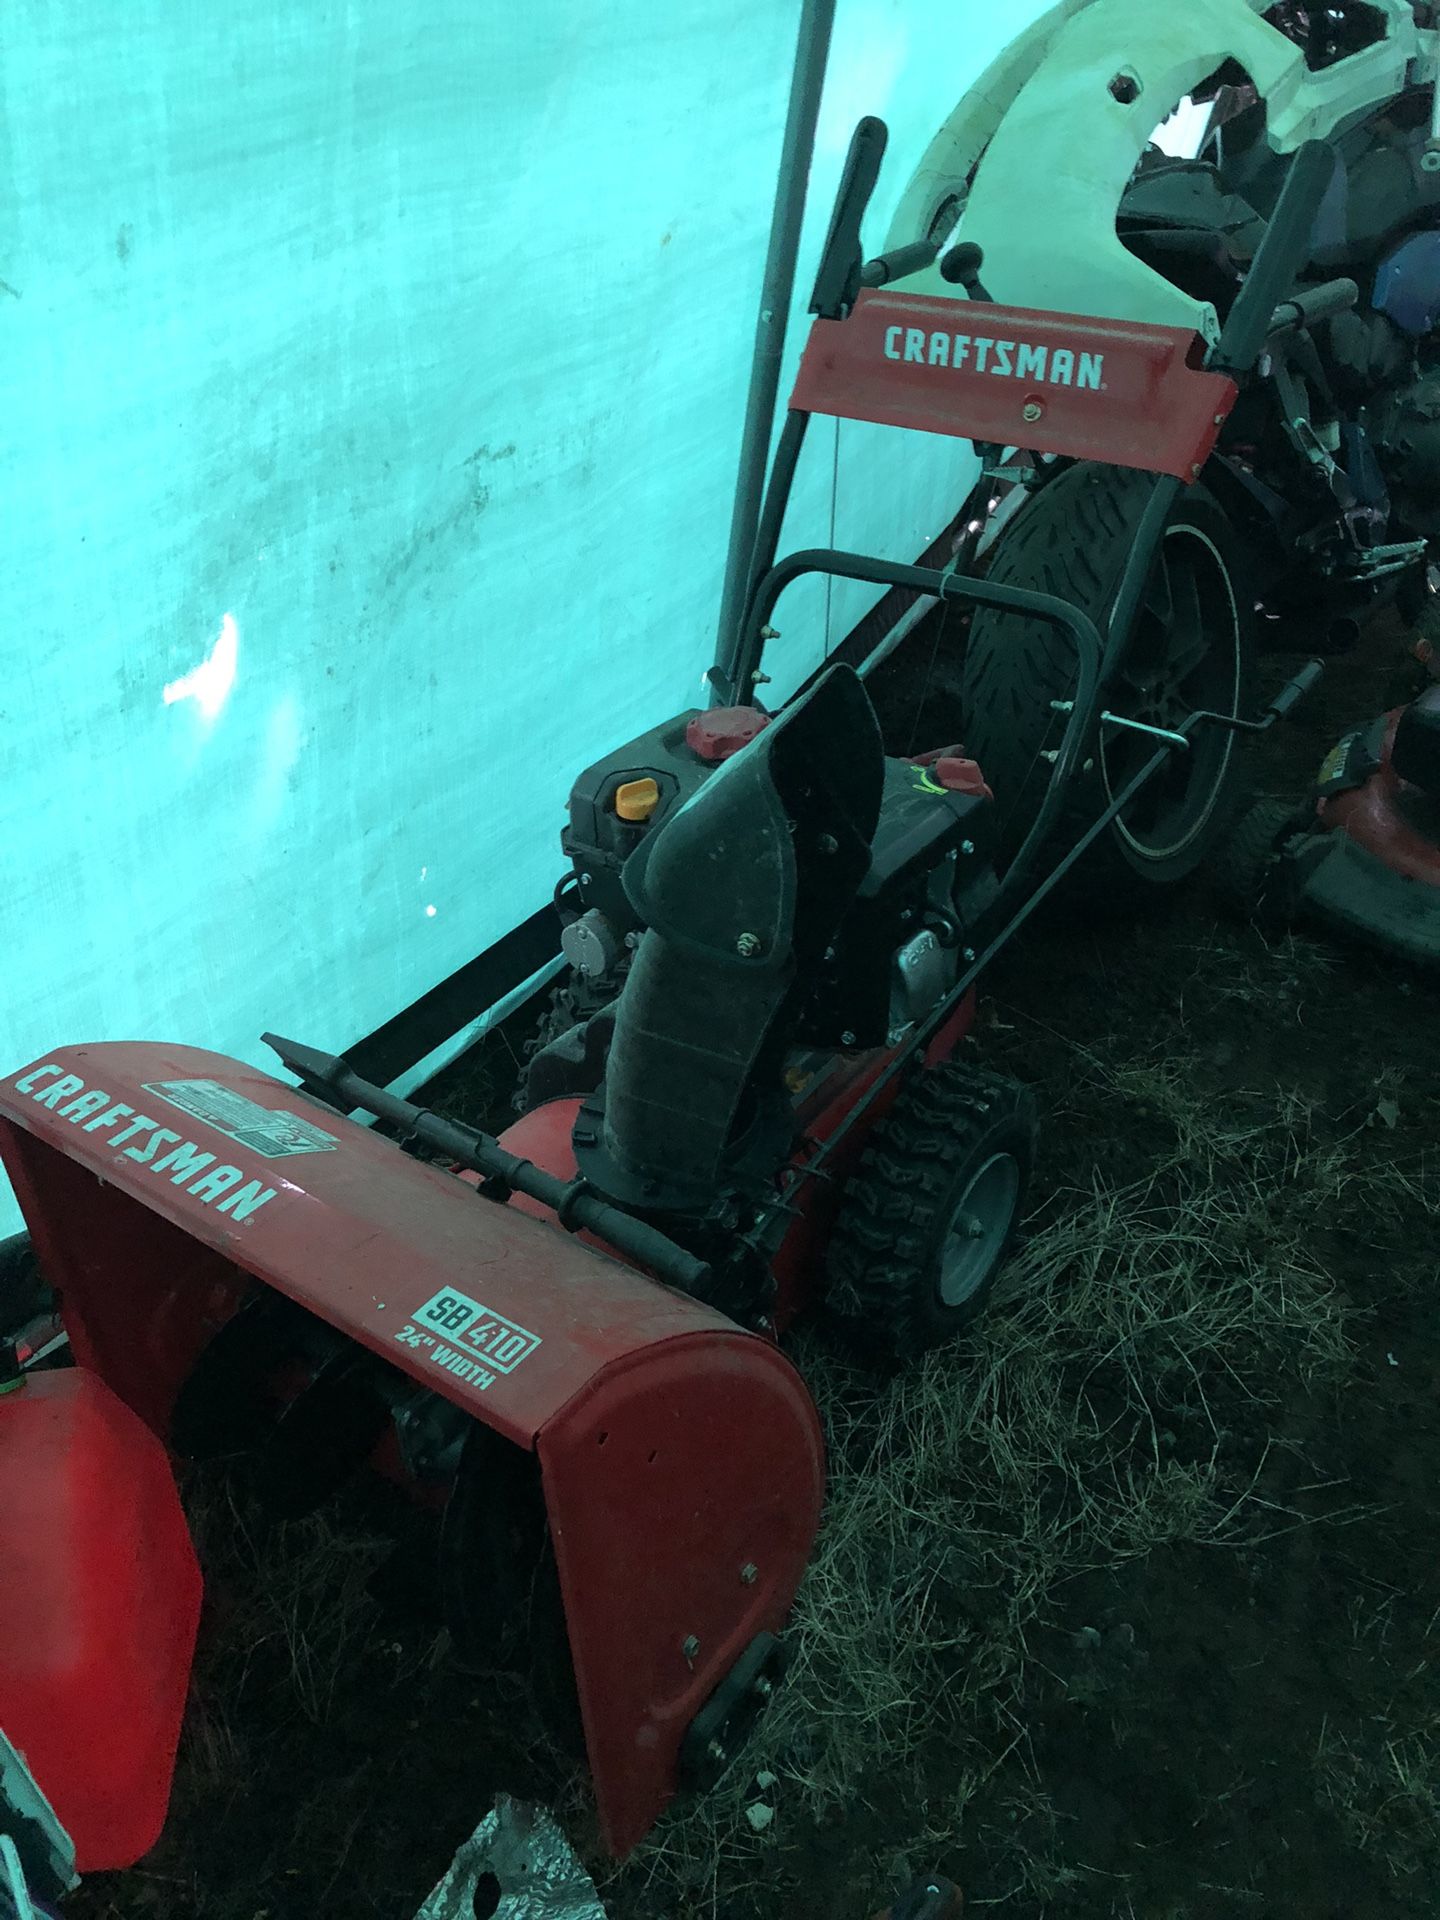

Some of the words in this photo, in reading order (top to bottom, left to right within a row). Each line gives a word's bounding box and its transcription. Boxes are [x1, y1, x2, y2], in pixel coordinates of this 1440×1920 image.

[884, 325, 1105, 391] CRAFTSMAN
[15, 1064, 279, 1223] CRAFTSMAN
[394, 1325, 437, 1349] 24"
[430, 1344, 497, 1391] WIDTH
[426, 1296, 474, 1331] SB
[468, 1321, 528, 1363] 410
